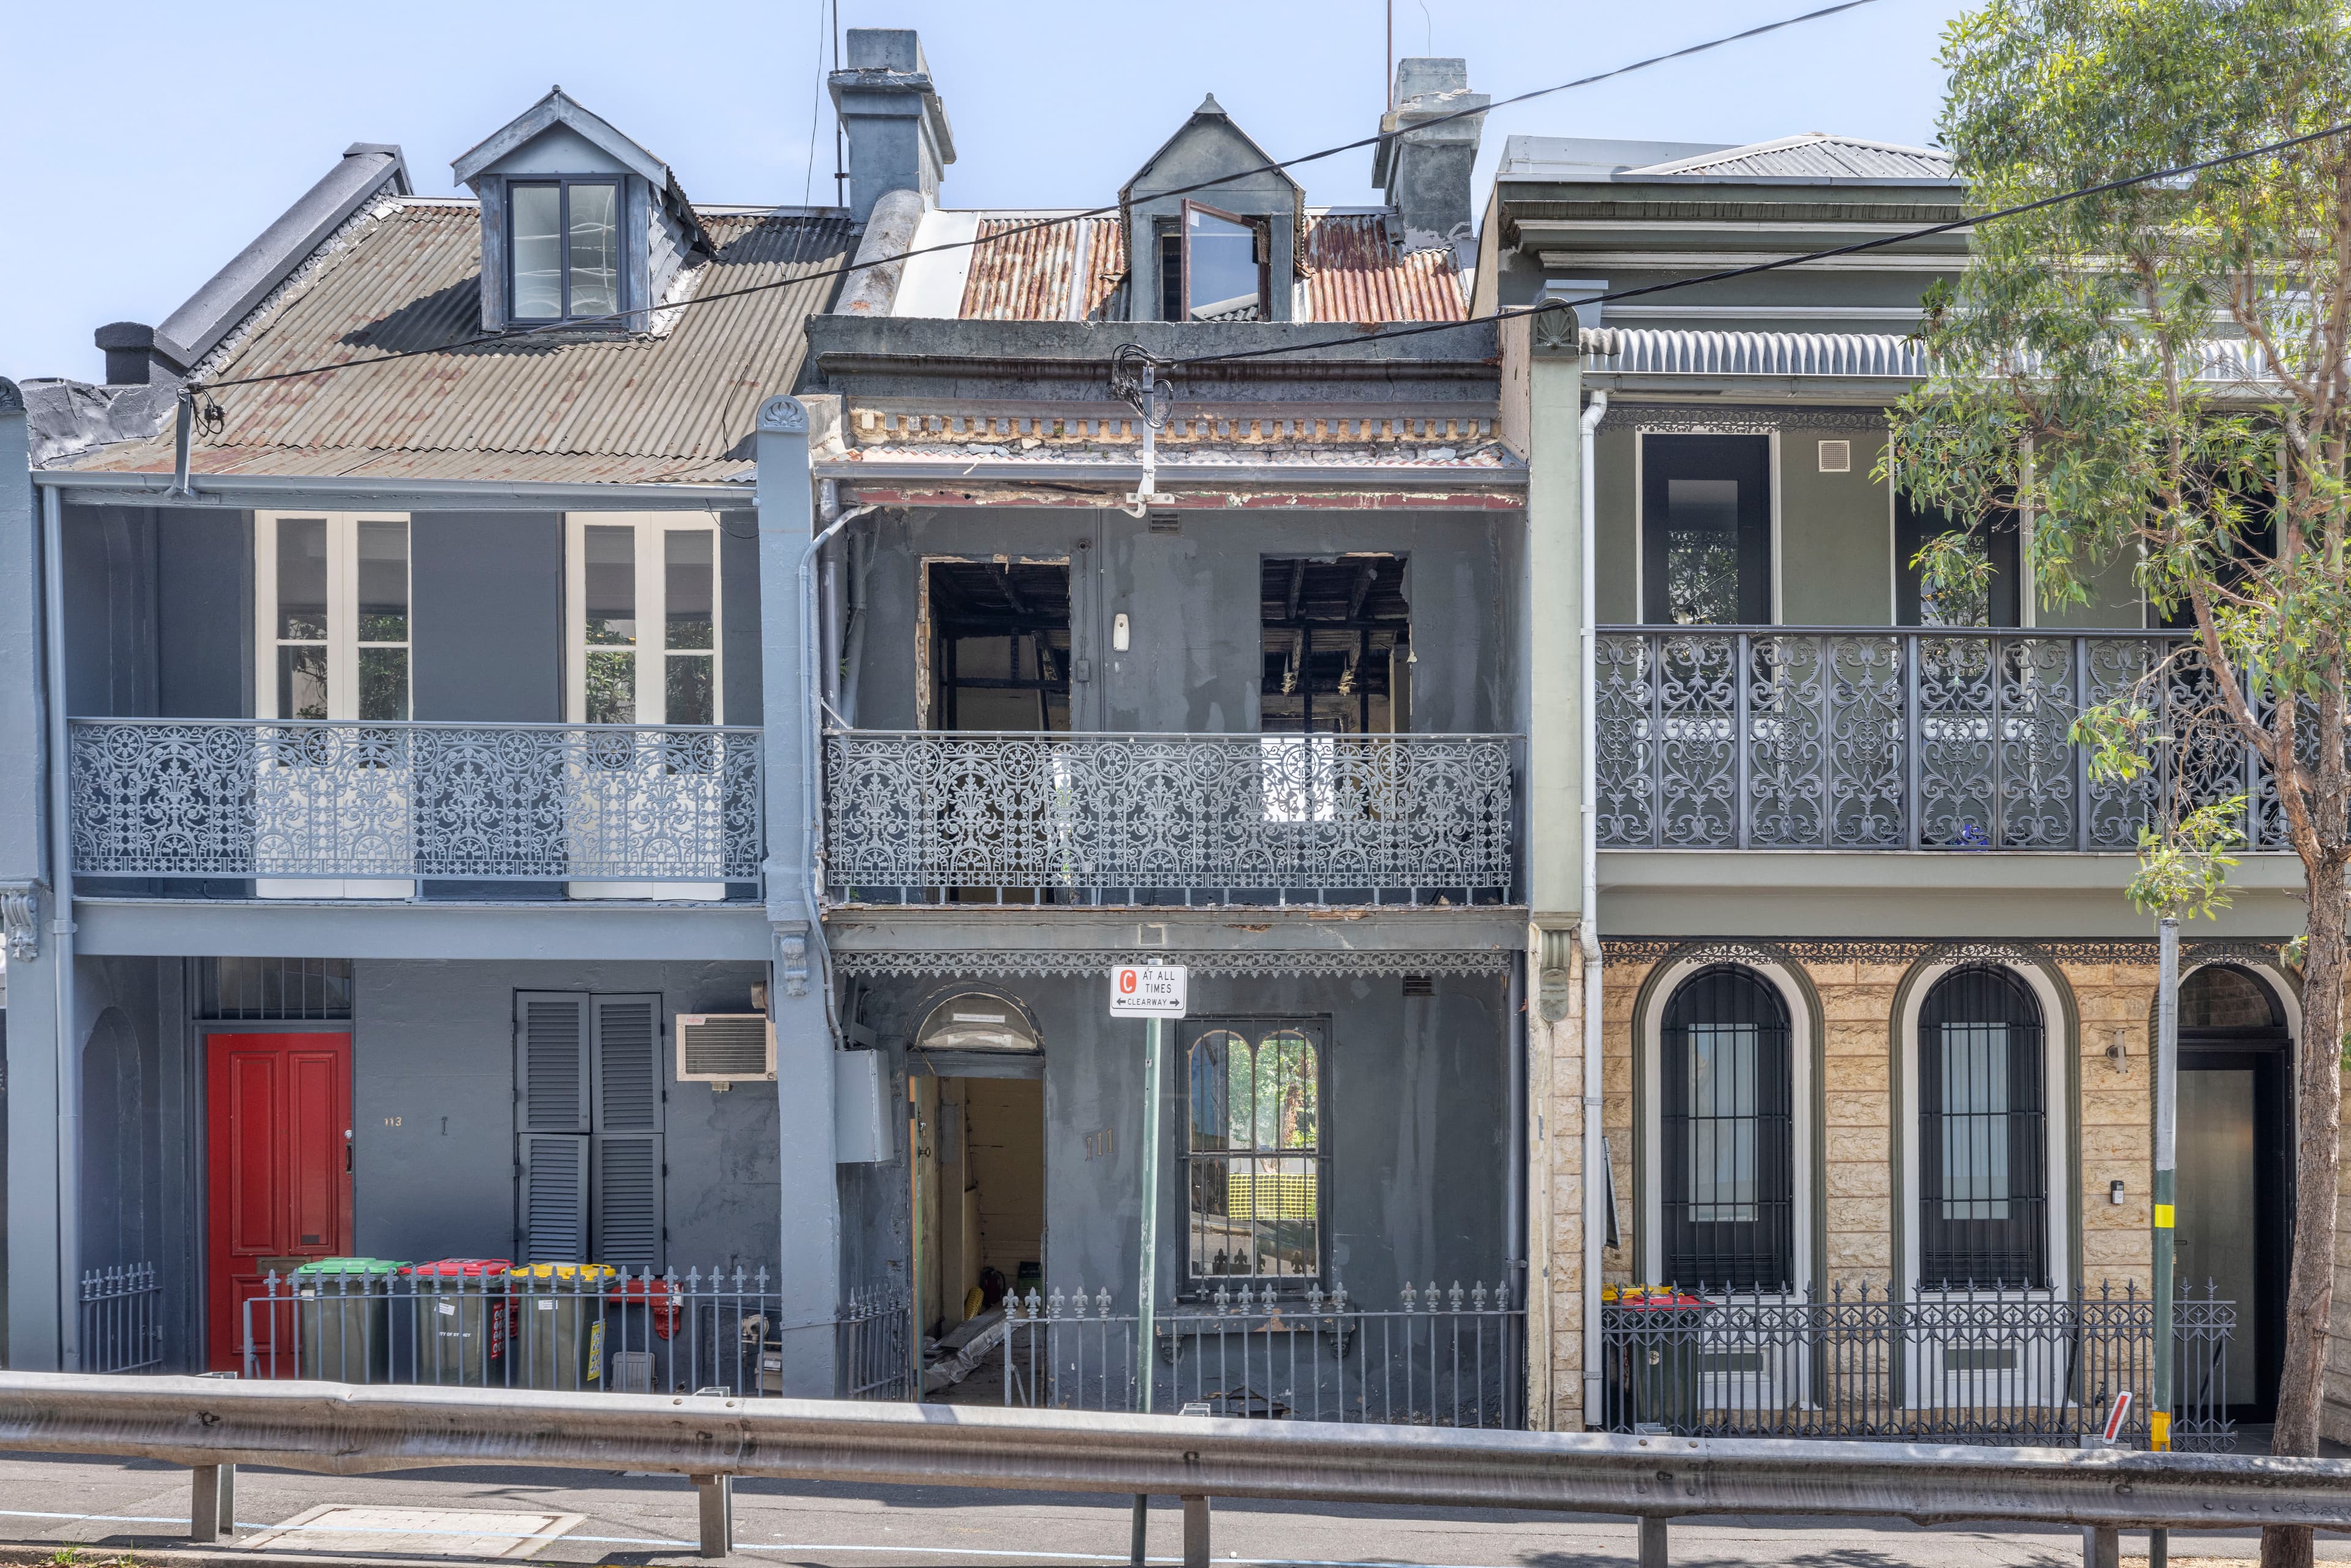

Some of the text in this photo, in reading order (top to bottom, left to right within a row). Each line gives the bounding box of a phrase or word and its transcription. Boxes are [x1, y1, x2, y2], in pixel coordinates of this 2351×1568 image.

[1142, 970, 1176, 980] AT ALL
[1123, 972, 1133, 992] C
[1146, 983, 1172, 994] TIMES
[384, 1116, 402, 1127] 113
